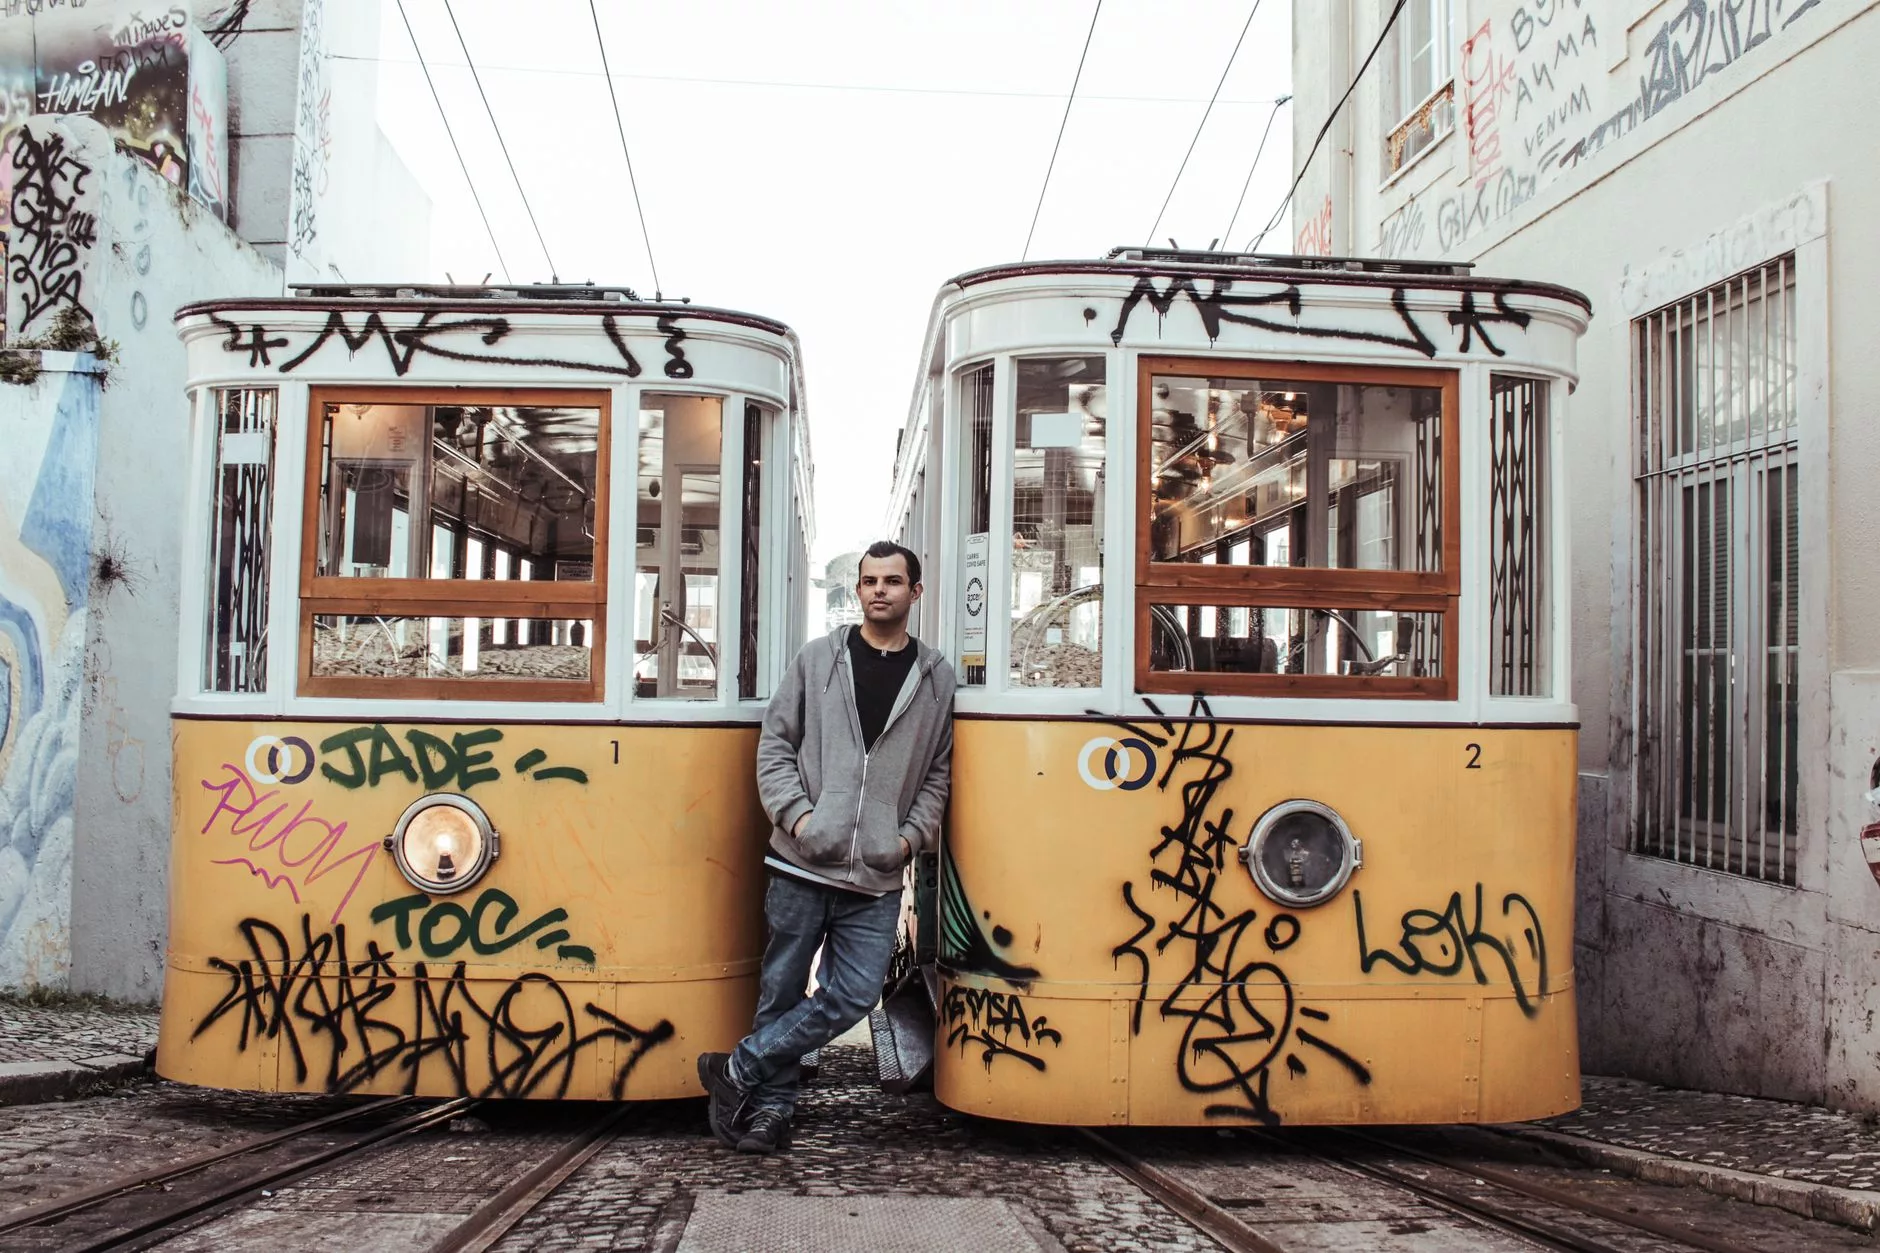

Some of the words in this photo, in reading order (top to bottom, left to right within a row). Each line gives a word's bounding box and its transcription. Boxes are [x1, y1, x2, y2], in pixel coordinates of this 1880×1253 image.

[319, 723, 503, 790] JADE
[610, 739, 620, 765] 1
[1464, 742, 1483, 770] 2
